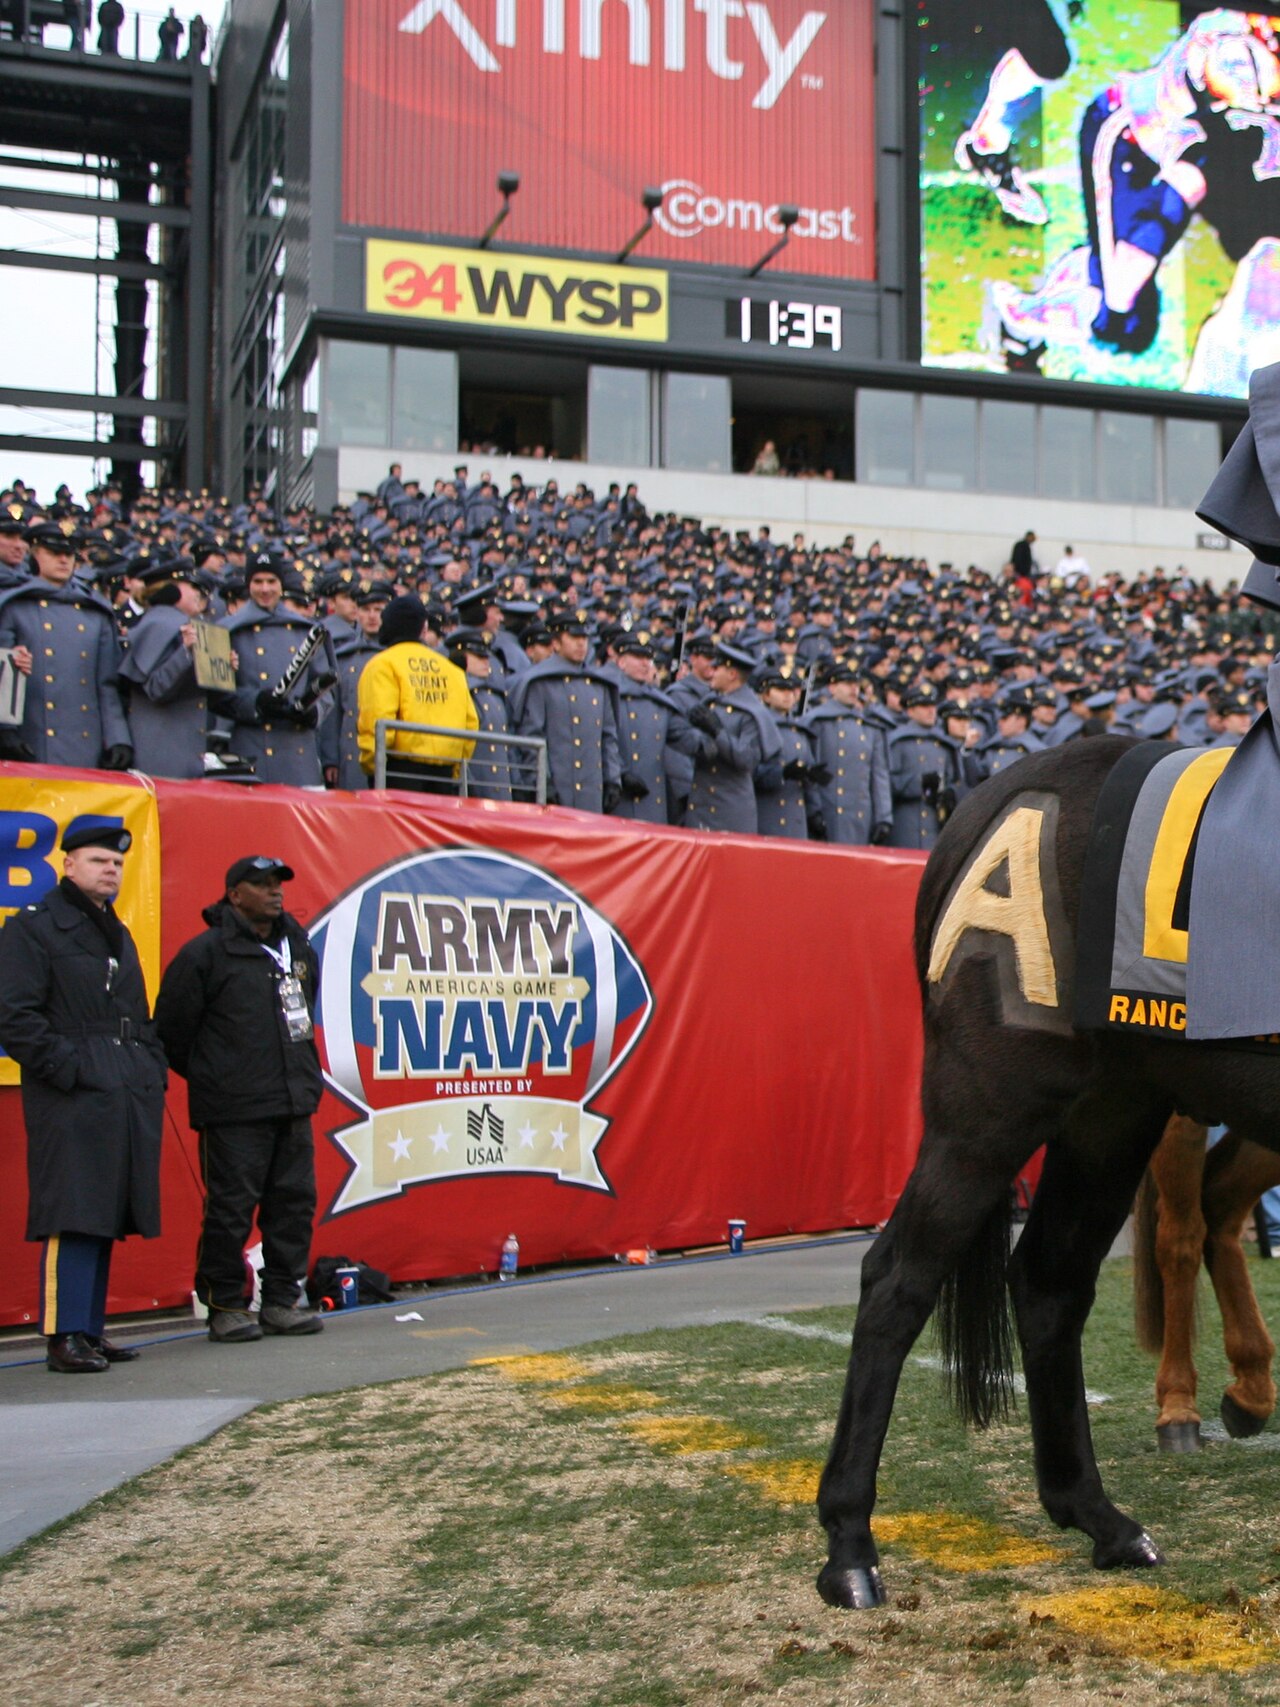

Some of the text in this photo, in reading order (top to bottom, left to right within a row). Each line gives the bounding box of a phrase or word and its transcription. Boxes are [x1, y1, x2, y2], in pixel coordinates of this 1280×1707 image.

[466, 266, 663, 330] WYSP
[740, 297, 842, 352] 11:39
[408, 657, 441, 674] CSC
[408, 673, 449, 689] EVENT
[414, 688, 449, 704] STAFF
[928, 807, 1058, 1008] A
[377, 897, 576, 977] ARMY
[405, 978, 558, 996] AMERICA'S GAME
[376, 998, 580, 1073] NAVY
[435, 1079, 533, 1095] PRESENTED BY
[466, 1146, 505, 1166] USAA
